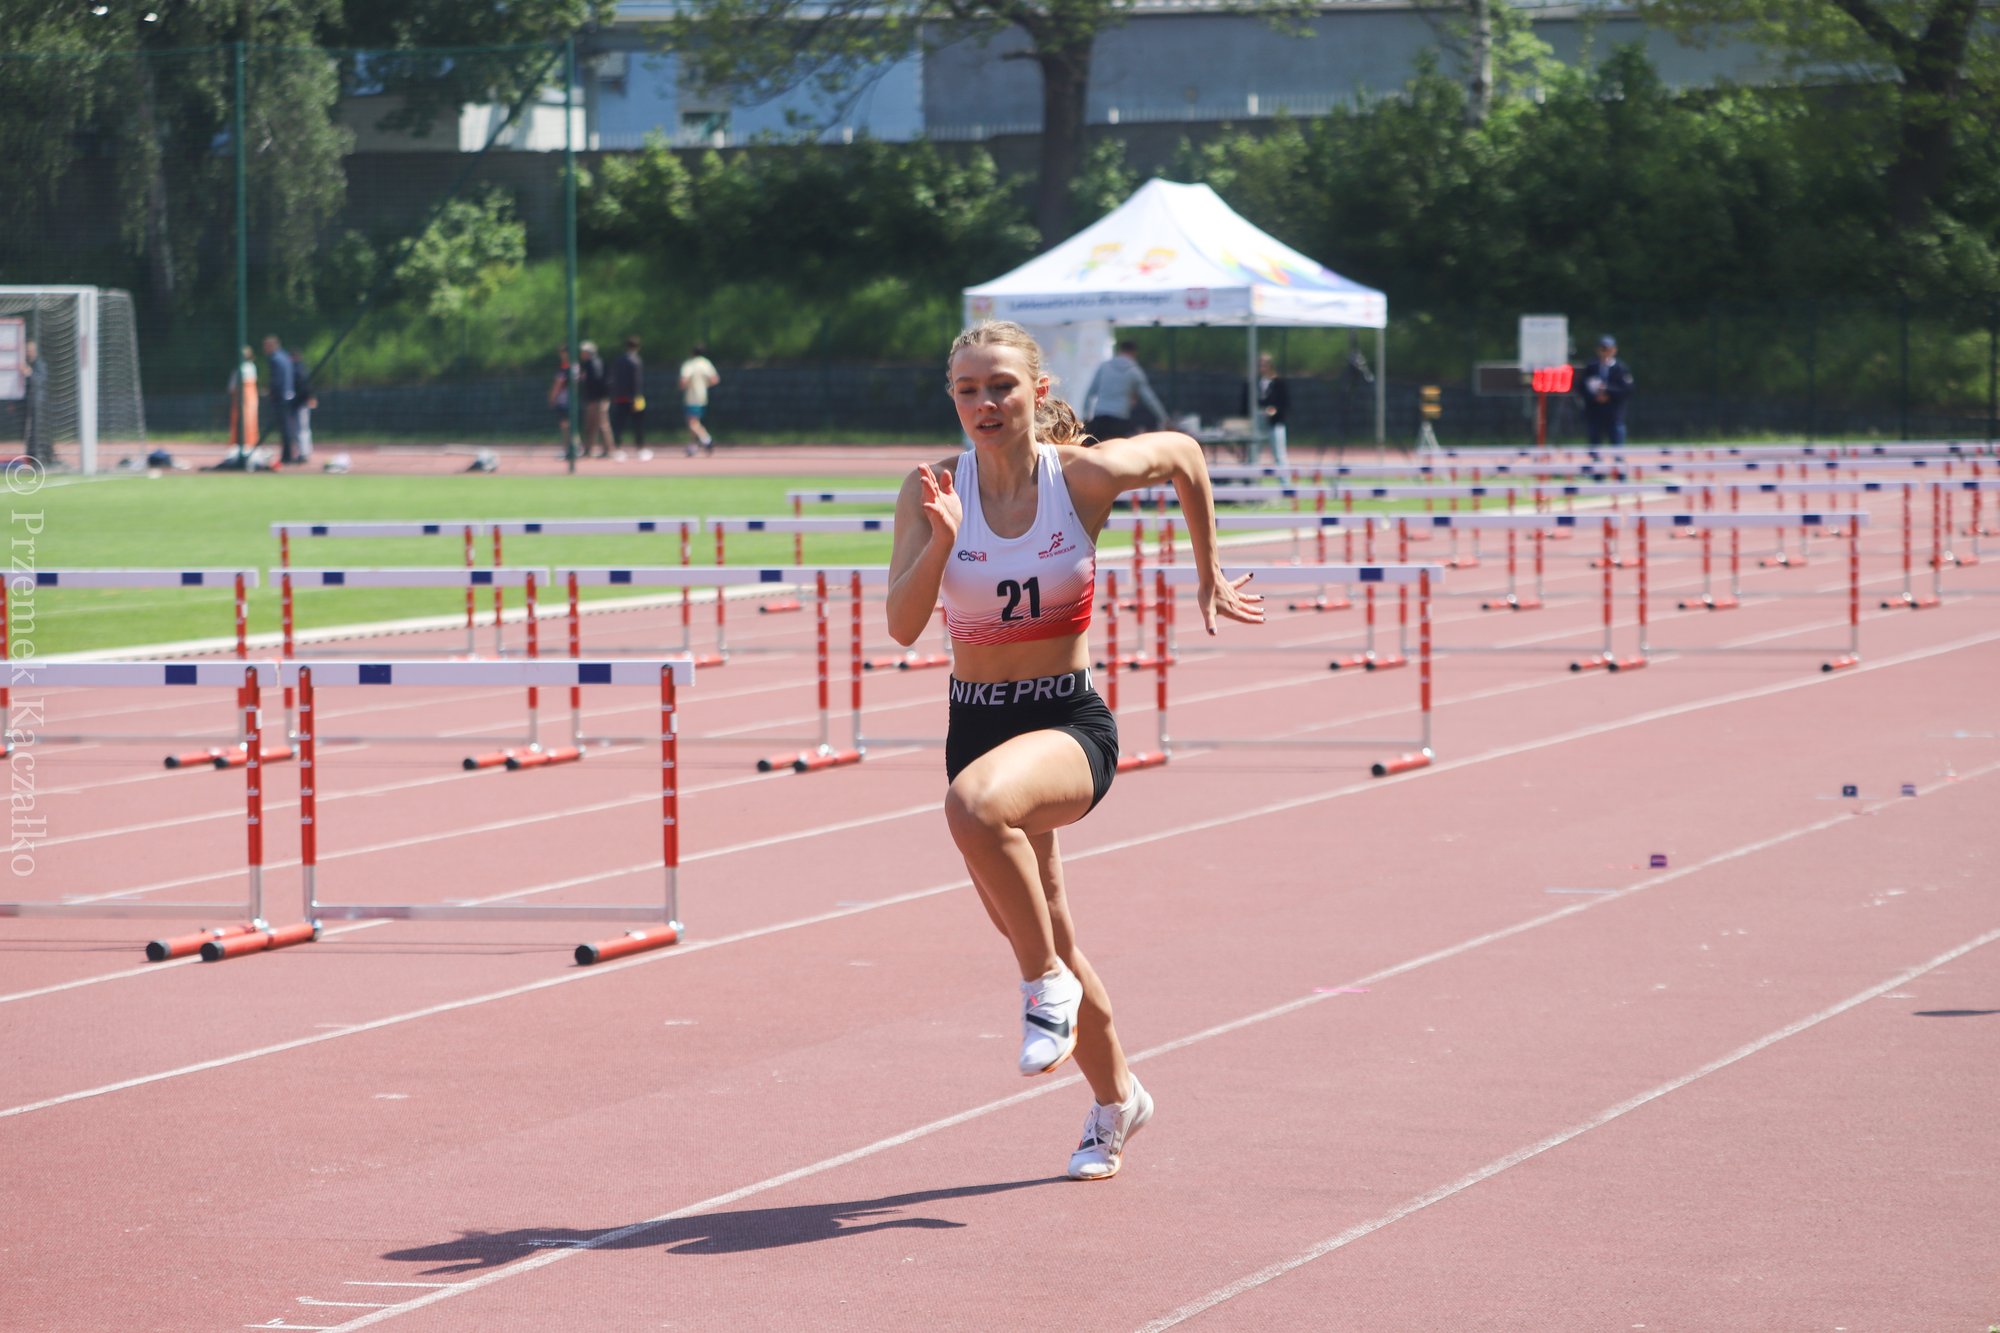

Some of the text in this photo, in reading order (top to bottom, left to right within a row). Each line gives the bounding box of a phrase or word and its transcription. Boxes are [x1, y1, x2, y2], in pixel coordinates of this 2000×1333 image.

[957, 549, 987, 562] esa
[997, 577, 1040, 621] 21
[950, 680, 1008, 705] NIKE
[1013, 673, 1076, 704] PRO
